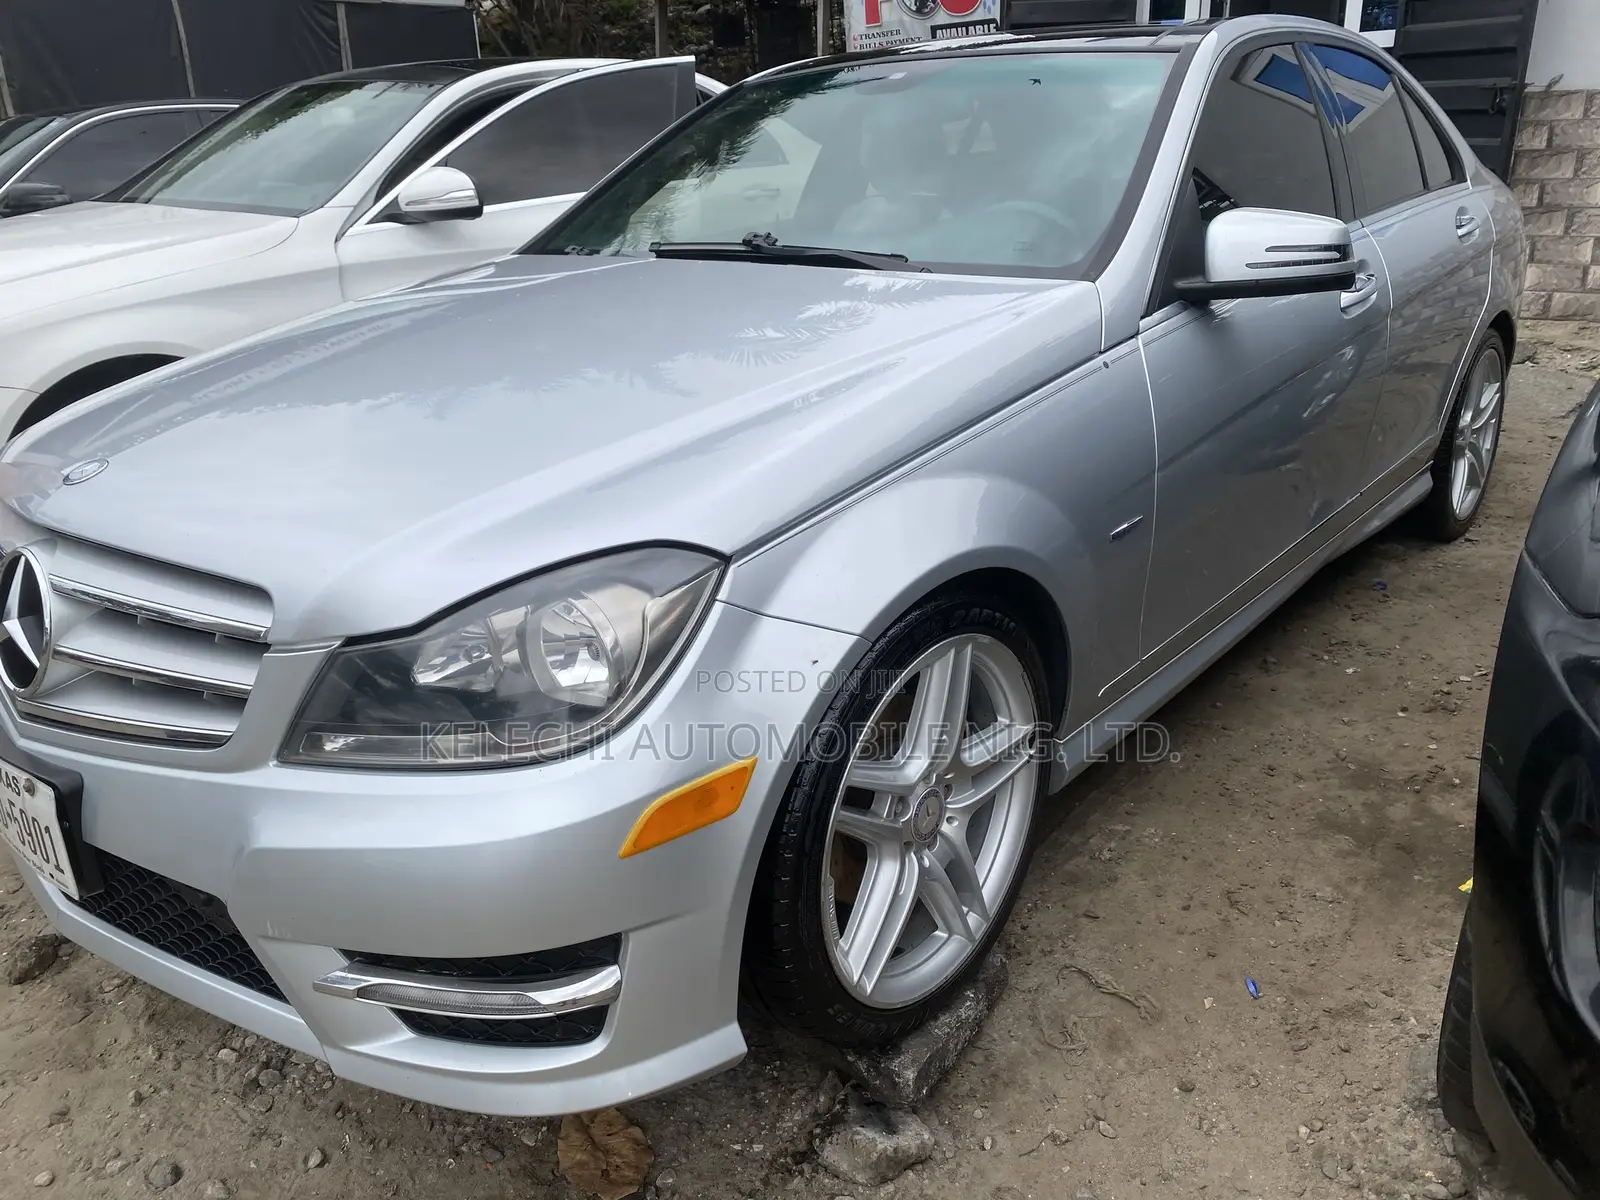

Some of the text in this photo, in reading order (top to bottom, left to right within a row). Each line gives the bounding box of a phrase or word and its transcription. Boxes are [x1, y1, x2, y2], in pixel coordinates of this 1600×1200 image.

[859, 28, 901, 41] TRANSFER
[936, 23, 997, 39] AVAILABLE
[859, 36, 923, 51] BILLS PAYMENT
